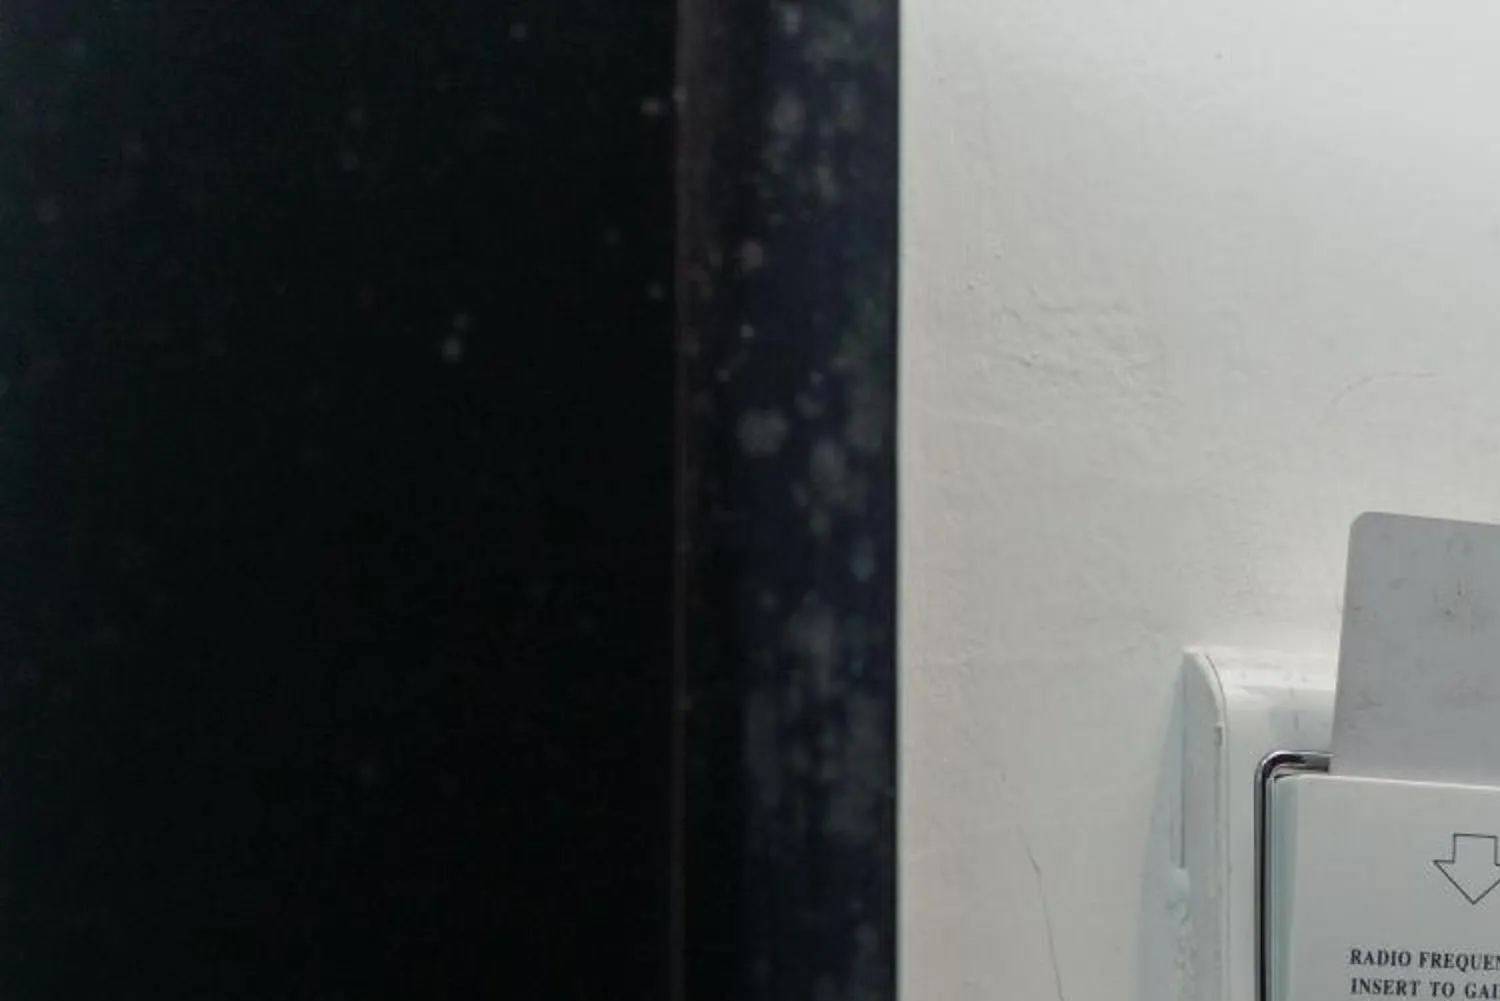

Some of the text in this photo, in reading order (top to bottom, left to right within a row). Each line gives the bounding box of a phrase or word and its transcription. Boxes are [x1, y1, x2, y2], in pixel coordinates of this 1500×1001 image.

[1350, 949, 1412, 967] RADIO
[1350, 977, 1421, 997] INSERT
[1429, 980, 1455, 998] TO
